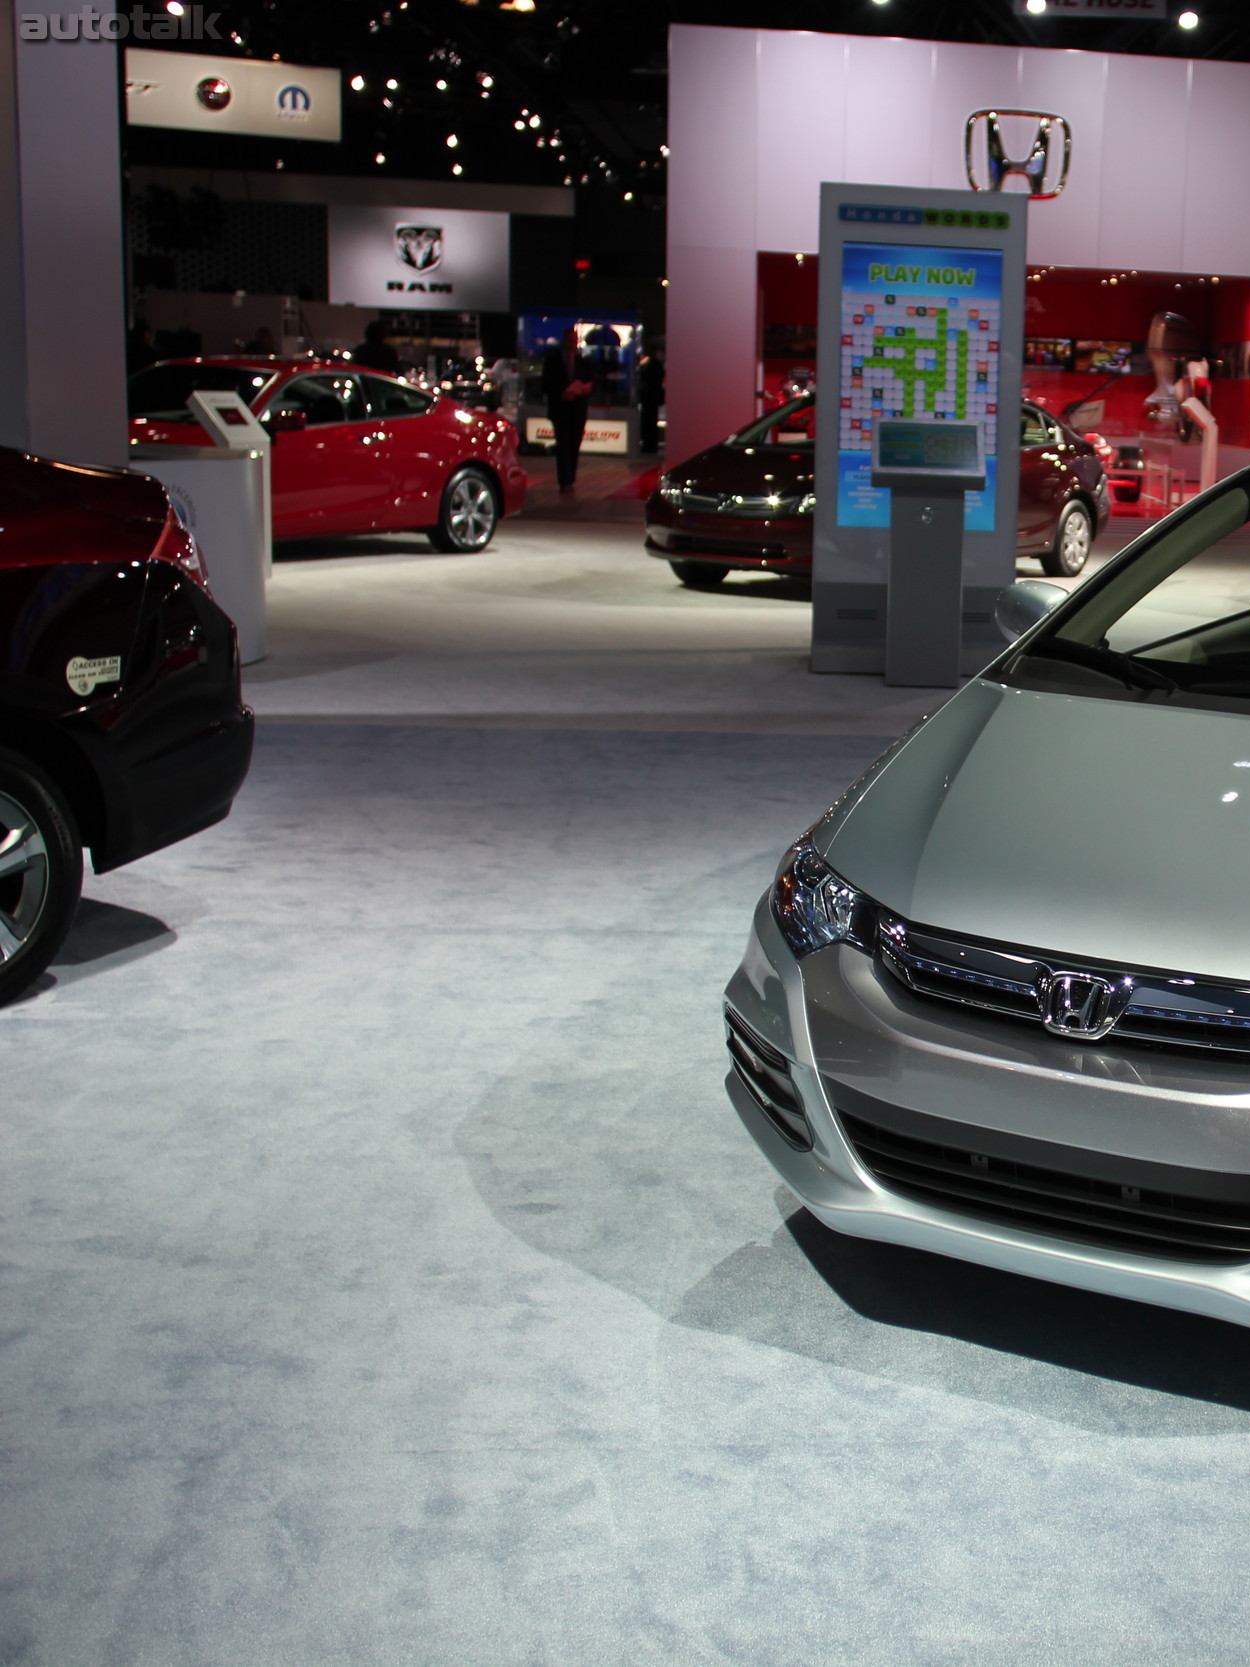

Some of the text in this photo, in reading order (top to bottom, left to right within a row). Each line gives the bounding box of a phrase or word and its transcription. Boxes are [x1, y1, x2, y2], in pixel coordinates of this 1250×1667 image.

[846, 208, 1006, 226] Honda WORDS
[869, 263, 976, 286] PLAY NOW
[387, 281, 453, 295] RAM
